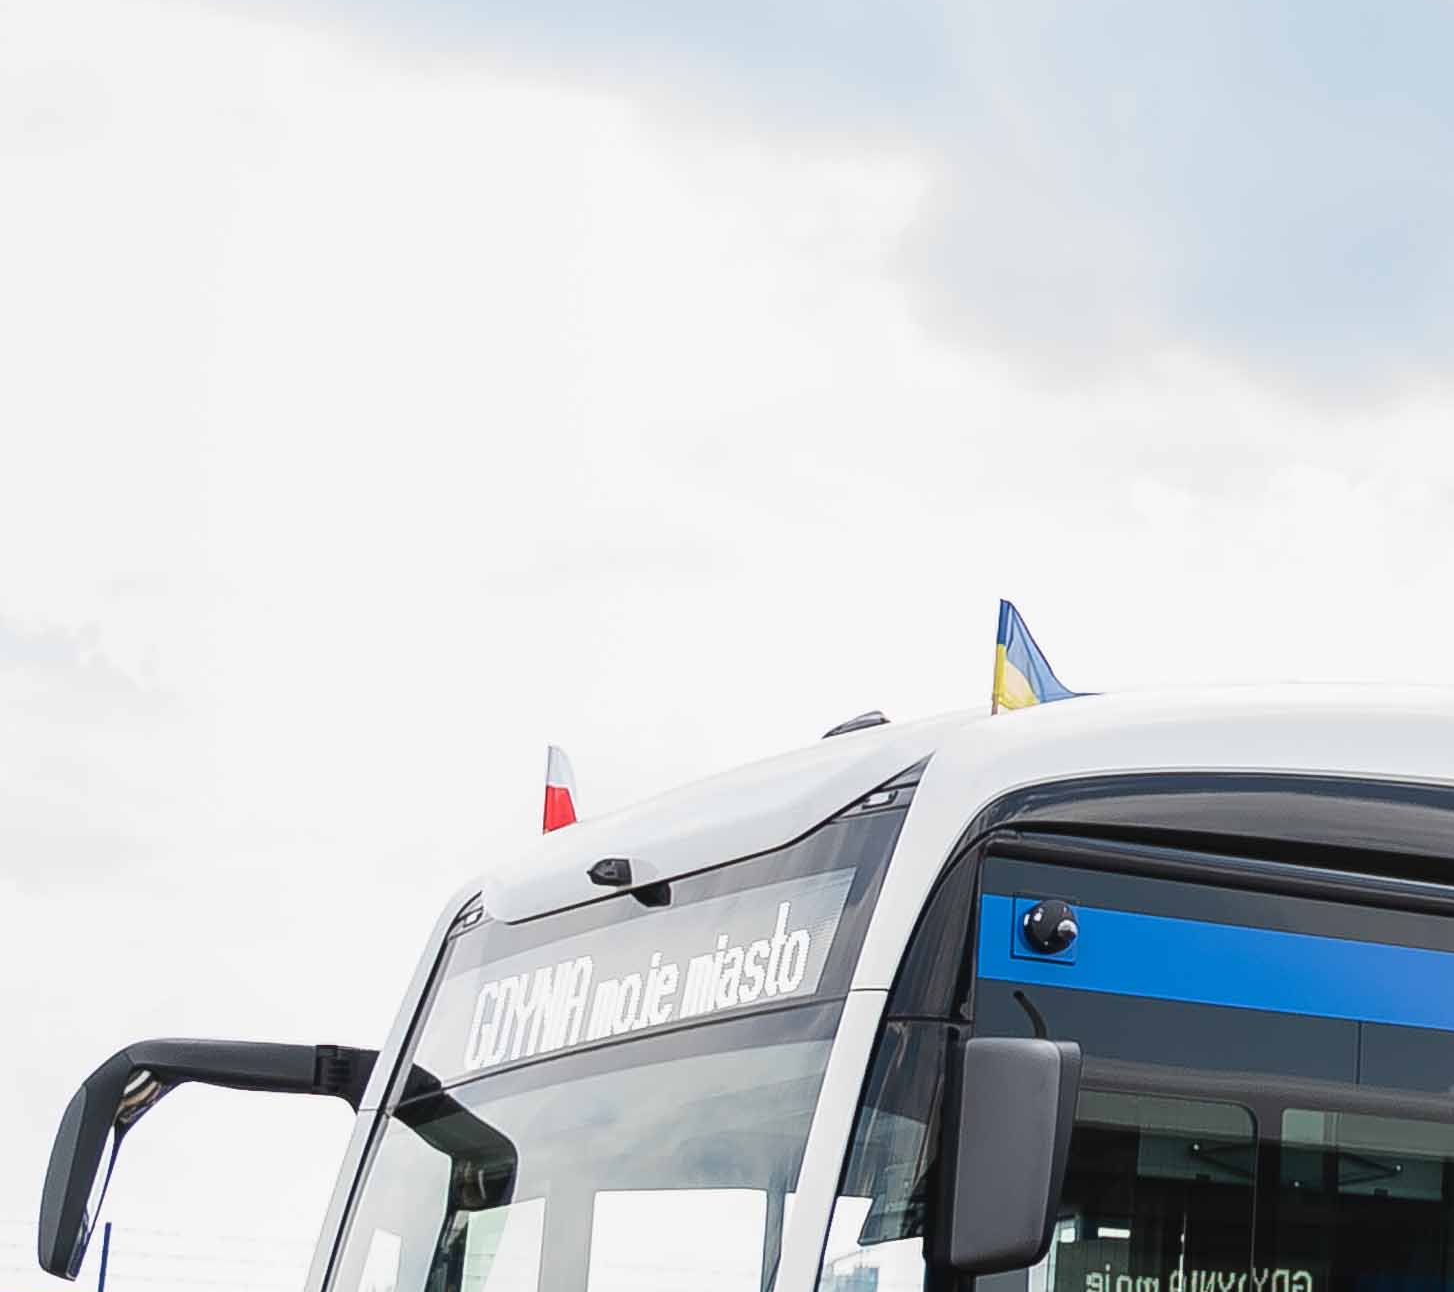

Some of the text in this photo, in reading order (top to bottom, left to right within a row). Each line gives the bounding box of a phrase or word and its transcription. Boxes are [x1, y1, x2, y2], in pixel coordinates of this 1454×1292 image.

[464, 901, 812, 1071] GDYNIA moje miasto
